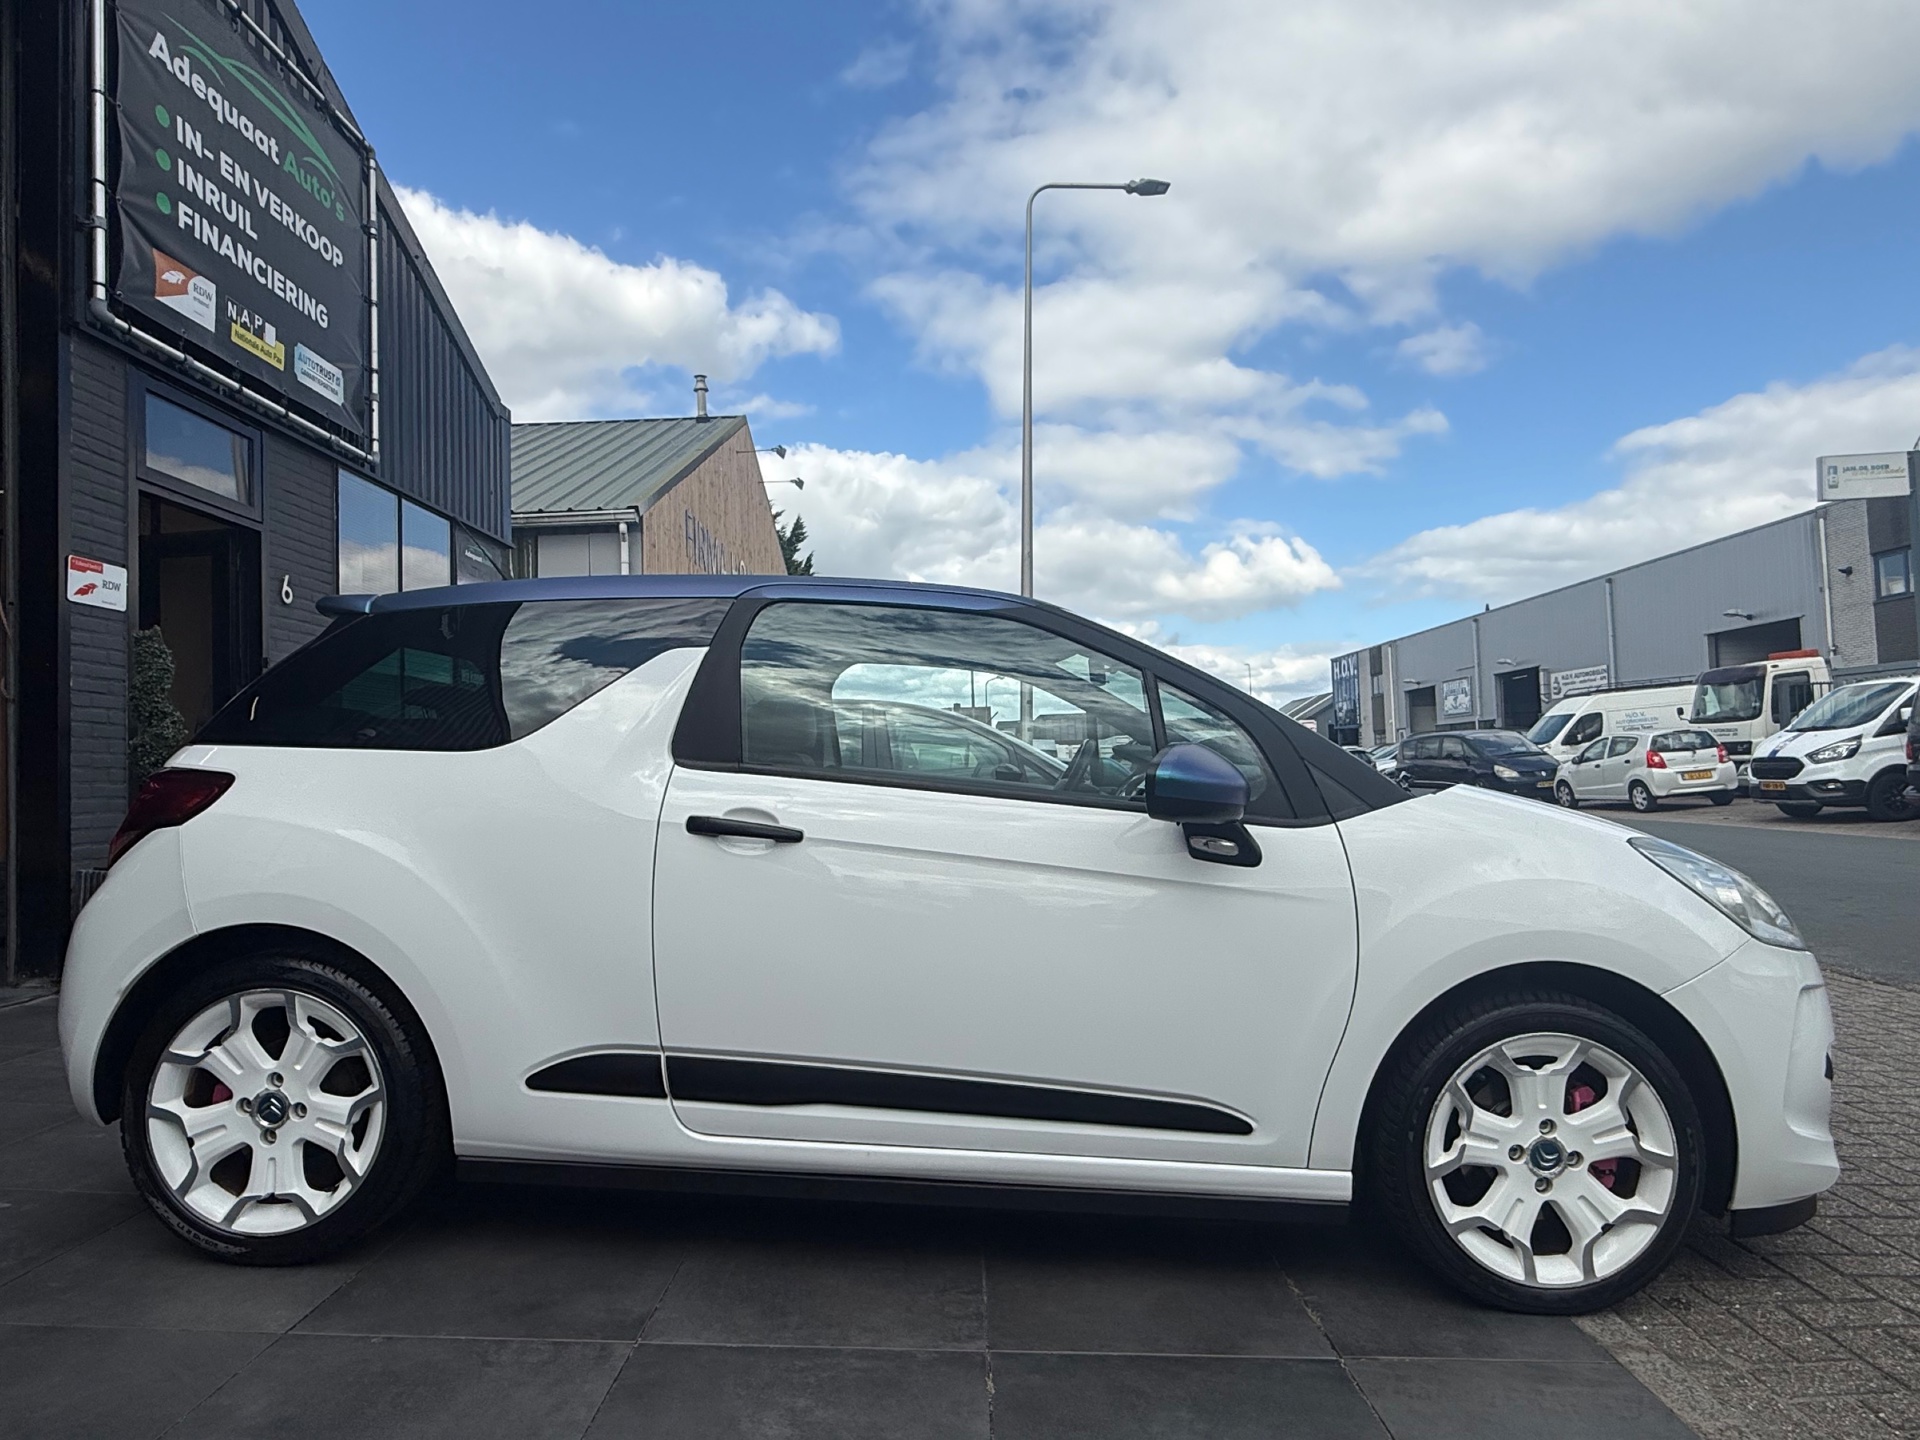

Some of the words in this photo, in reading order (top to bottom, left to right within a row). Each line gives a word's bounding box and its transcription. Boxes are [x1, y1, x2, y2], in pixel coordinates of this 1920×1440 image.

[148, 31, 280, 165] Adequaat
[283, 151, 345, 222] Auto's
[176, 115, 214, 161] IN-
[220, 150, 250, 197] EN
[253, 178, 344, 268] VERKOOP
[177, 158, 258, 241] INRUIL
[178, 201, 328, 329] FINANCIERING
[193, 282, 213, 302] RDW
[298, 352, 336, 384] AUTOTRUST
[102, 579, 121, 592] RDW
[281, 574, 294, 605] 6
